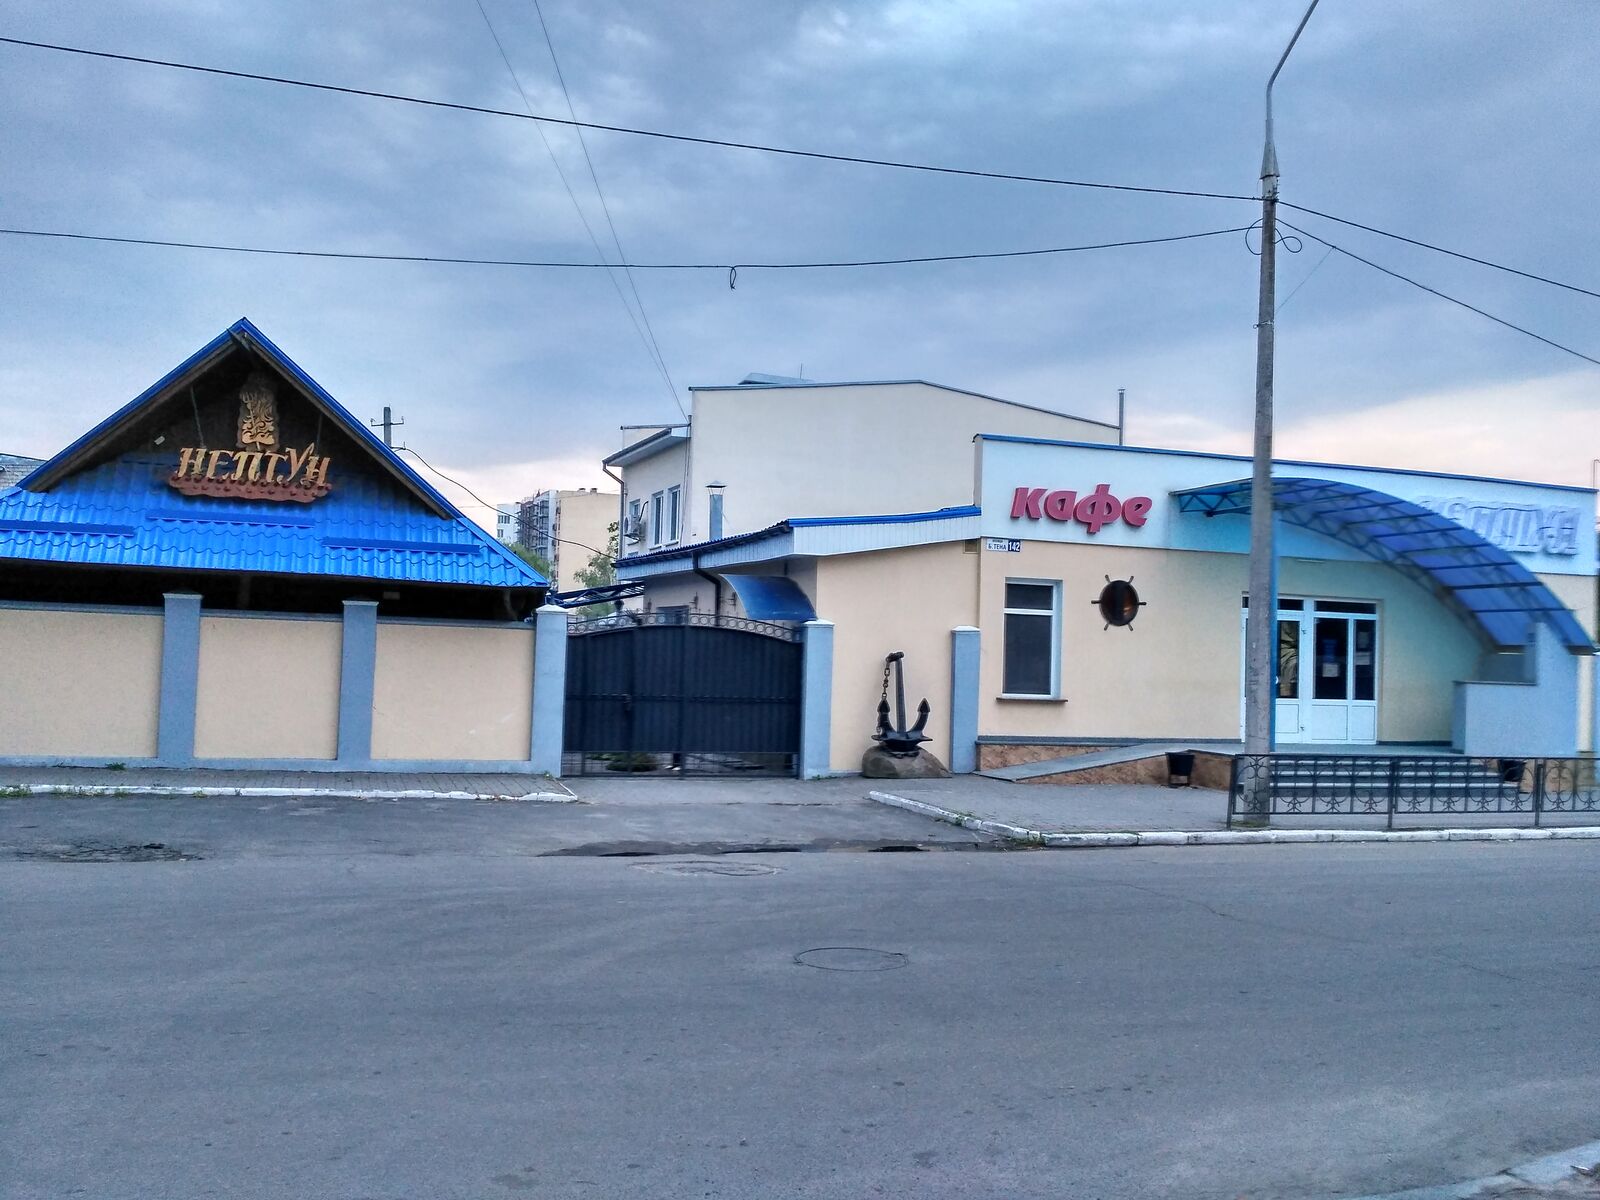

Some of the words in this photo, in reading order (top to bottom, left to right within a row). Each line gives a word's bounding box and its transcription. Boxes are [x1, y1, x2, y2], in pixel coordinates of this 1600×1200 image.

[175, 442, 330, 486] НЕПТУН
[1010, 484, 1152, 533] кафе
[1008, 542, 1020, 551] 142
